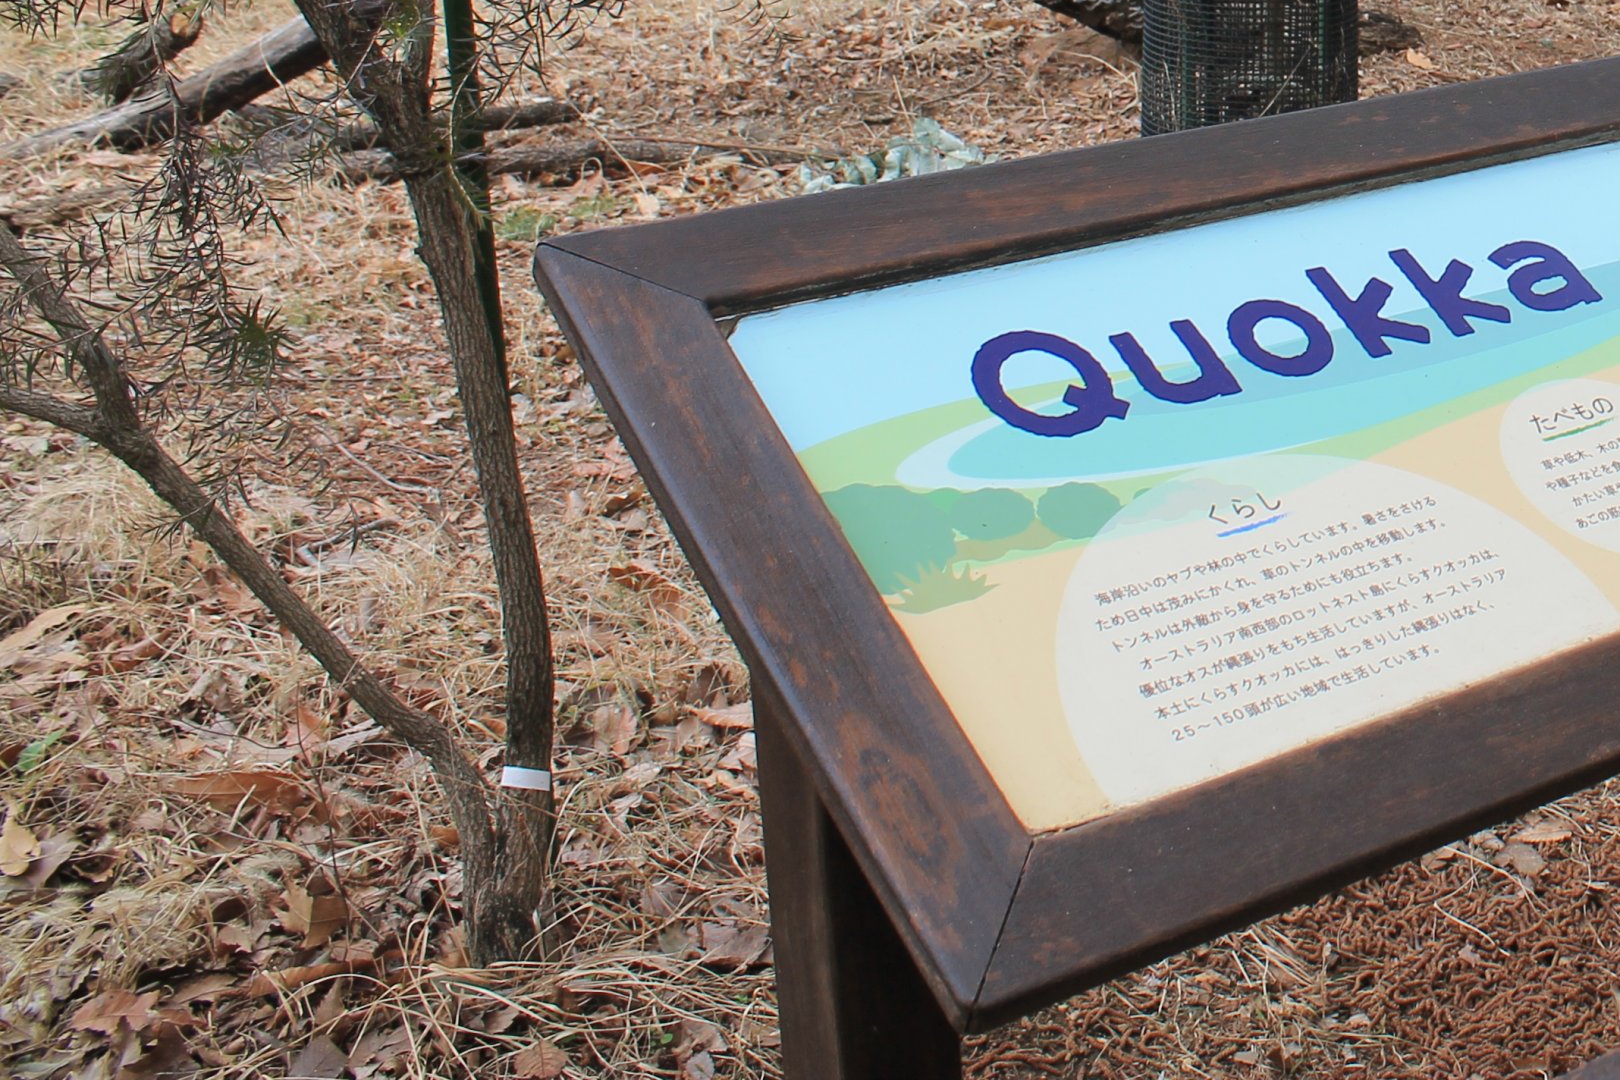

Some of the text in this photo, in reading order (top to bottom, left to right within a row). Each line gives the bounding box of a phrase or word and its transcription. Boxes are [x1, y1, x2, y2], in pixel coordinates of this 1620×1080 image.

[970, 239, 1603, 437] Quokka
[1529, 396, 1615, 434] たべもの
[1207, 491, 1283, 526] くらし
